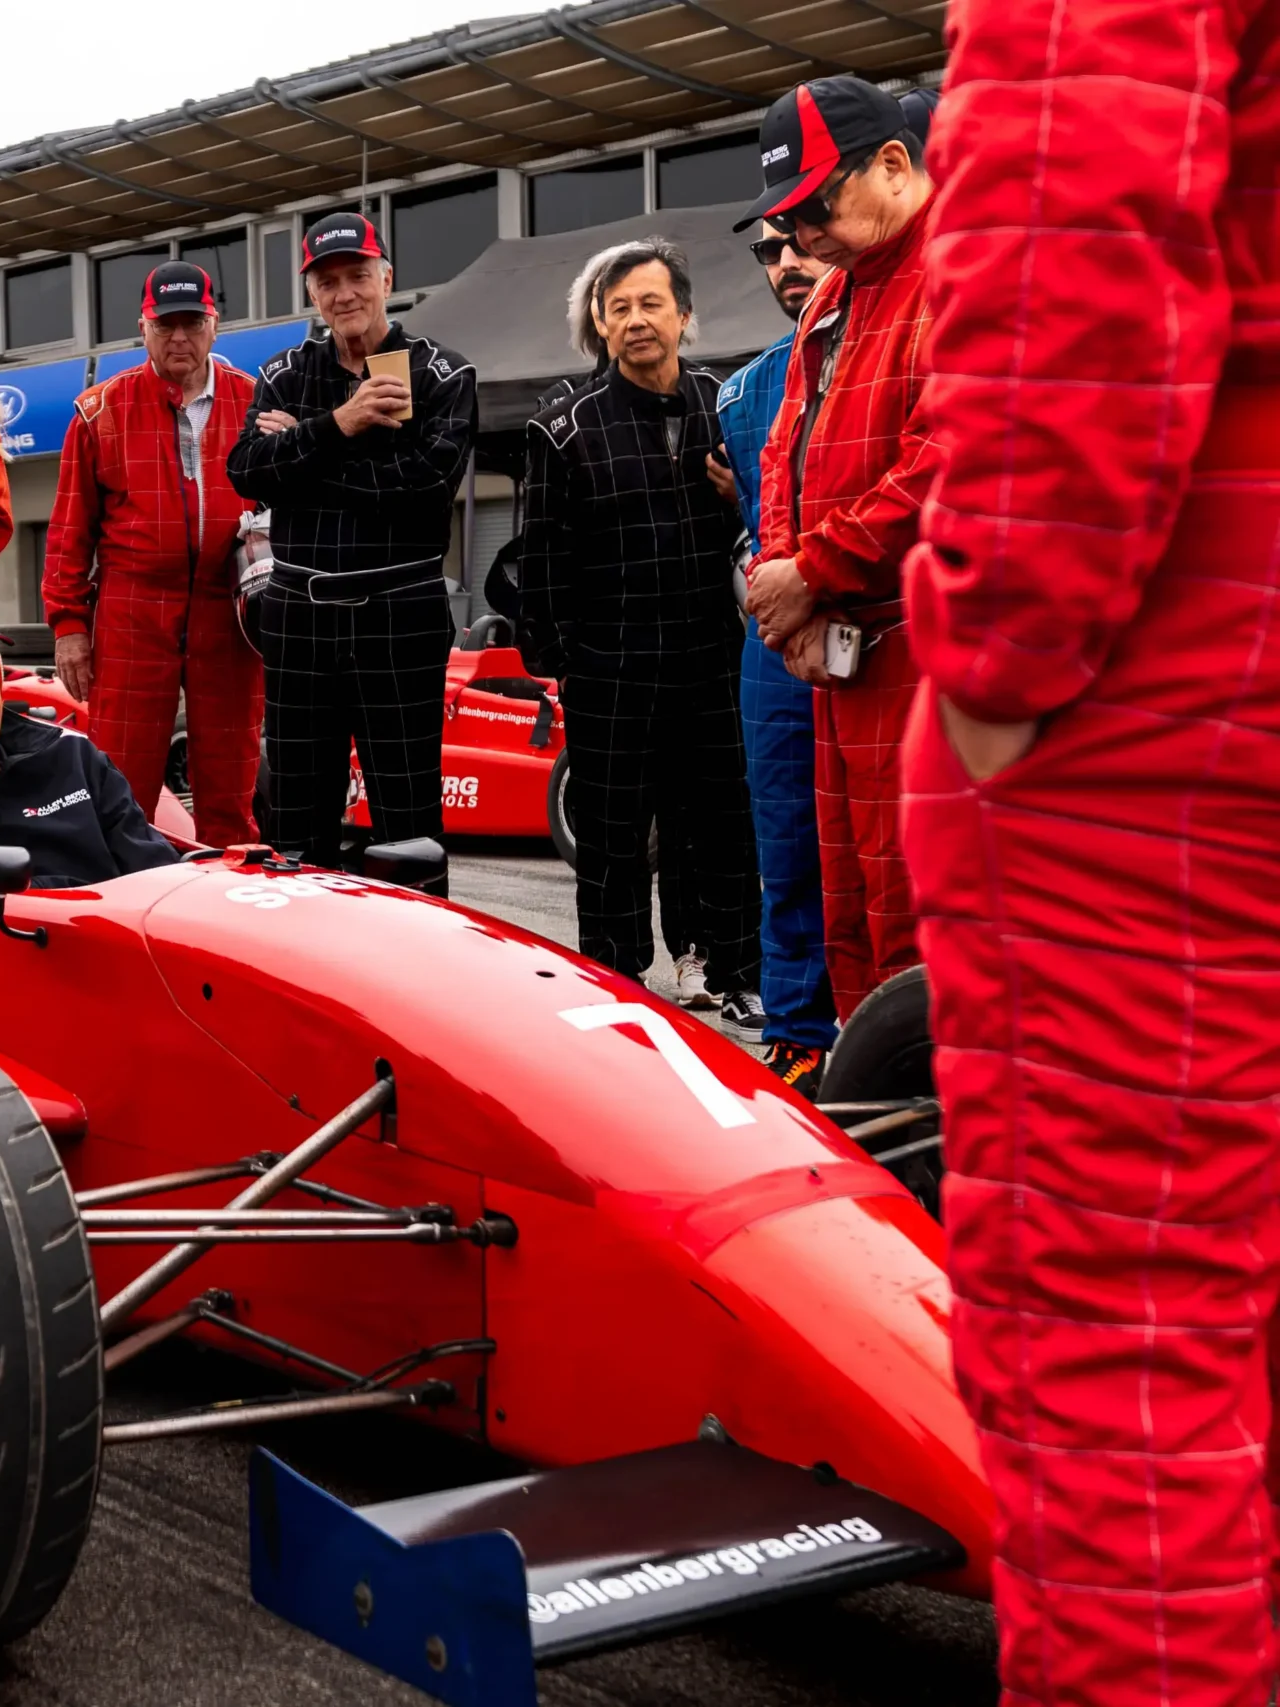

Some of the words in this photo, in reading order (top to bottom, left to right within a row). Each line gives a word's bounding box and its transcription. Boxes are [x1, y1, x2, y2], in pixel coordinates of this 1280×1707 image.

[38, 797, 63, 812] ALLEN
[64, 788, 87, 801] BERG
[556, 1002, 757, 1129] 7
